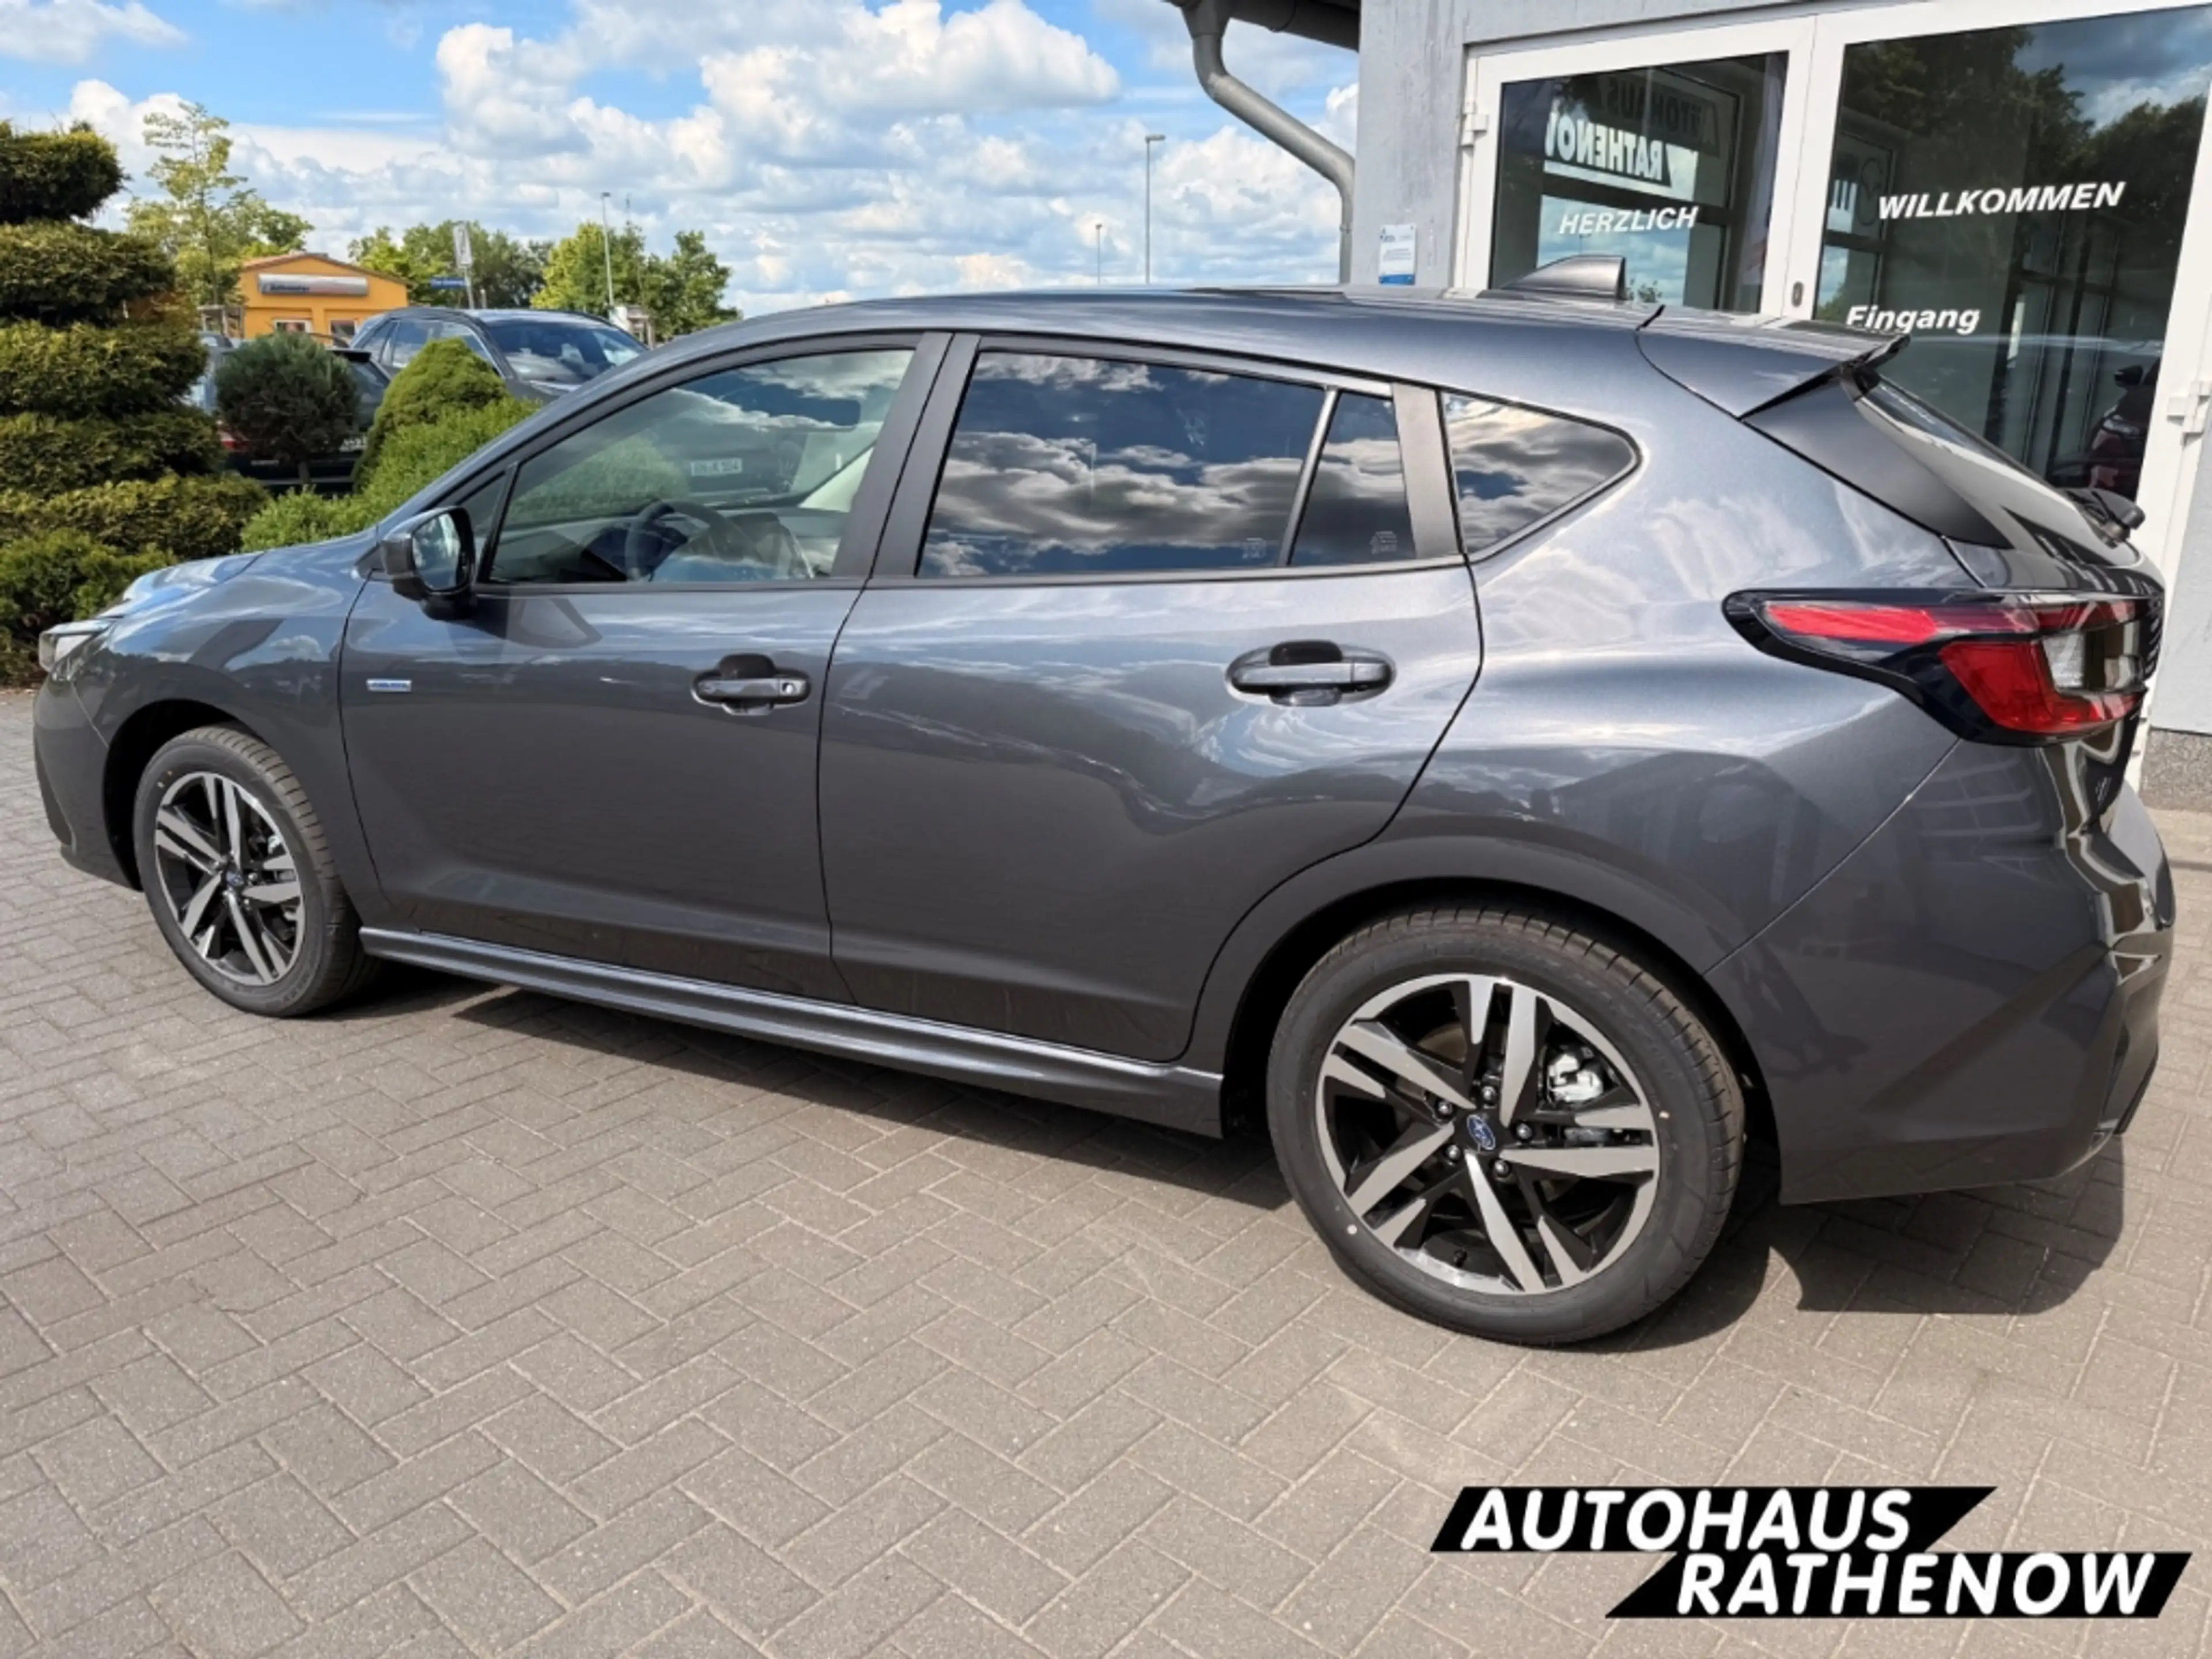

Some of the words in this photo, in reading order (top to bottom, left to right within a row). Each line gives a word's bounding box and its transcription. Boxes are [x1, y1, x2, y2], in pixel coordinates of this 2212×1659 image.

[1879, 181, 2126, 220] WILLKOMMEN
[1559, 206, 1699, 235] HERZLICH
[1846, 304, 1982, 336] Eingang
